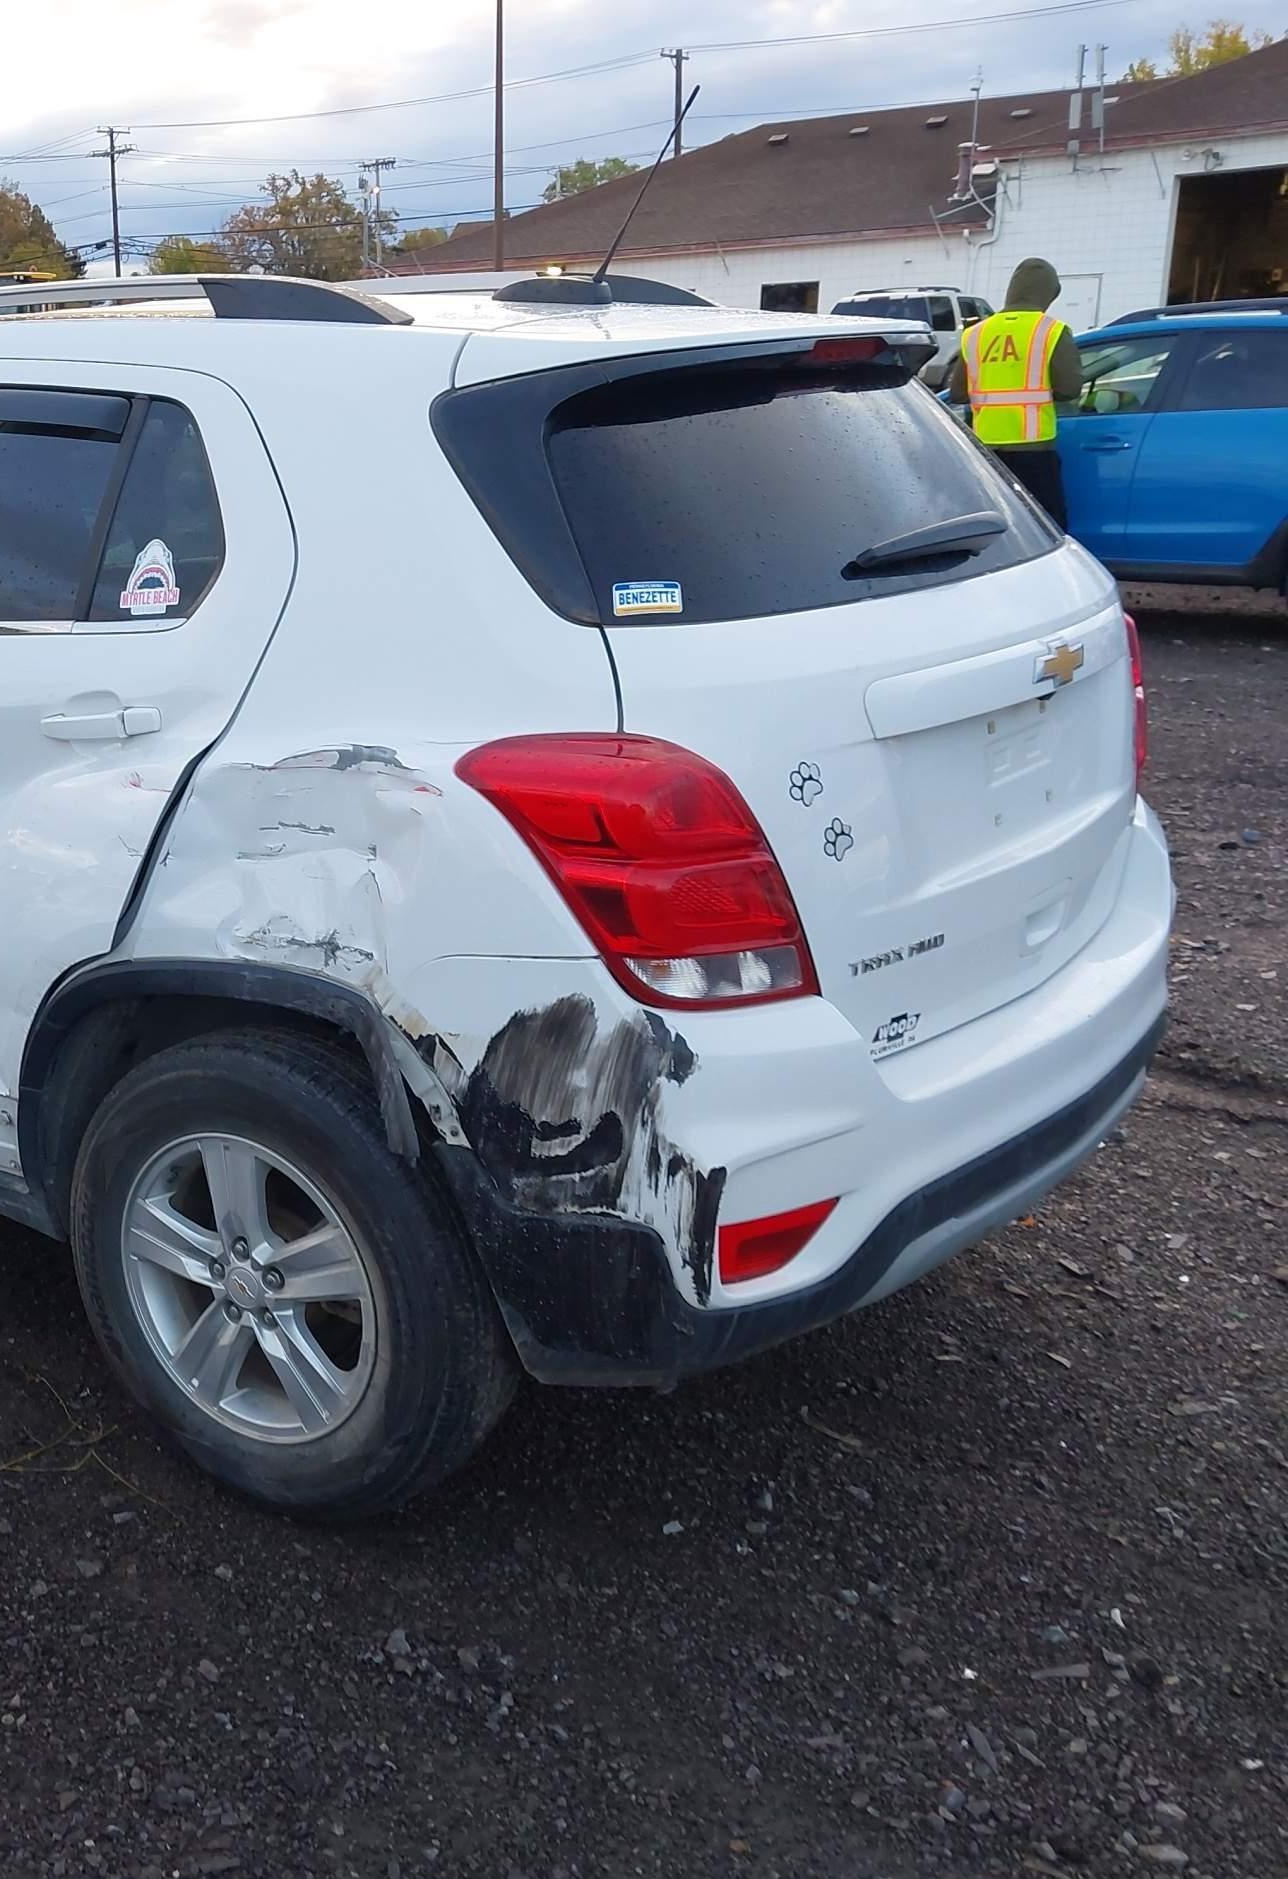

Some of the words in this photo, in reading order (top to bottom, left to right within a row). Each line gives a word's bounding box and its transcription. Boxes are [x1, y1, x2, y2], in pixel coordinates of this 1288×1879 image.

[122, 591, 151, 607] MYRTLE
[153, 588, 178, 604] BEACH
[618, 591, 677, 605] BENEZETTE
[848, 946, 905, 977] TRAX
[908, 933, 945, 958] AWD
